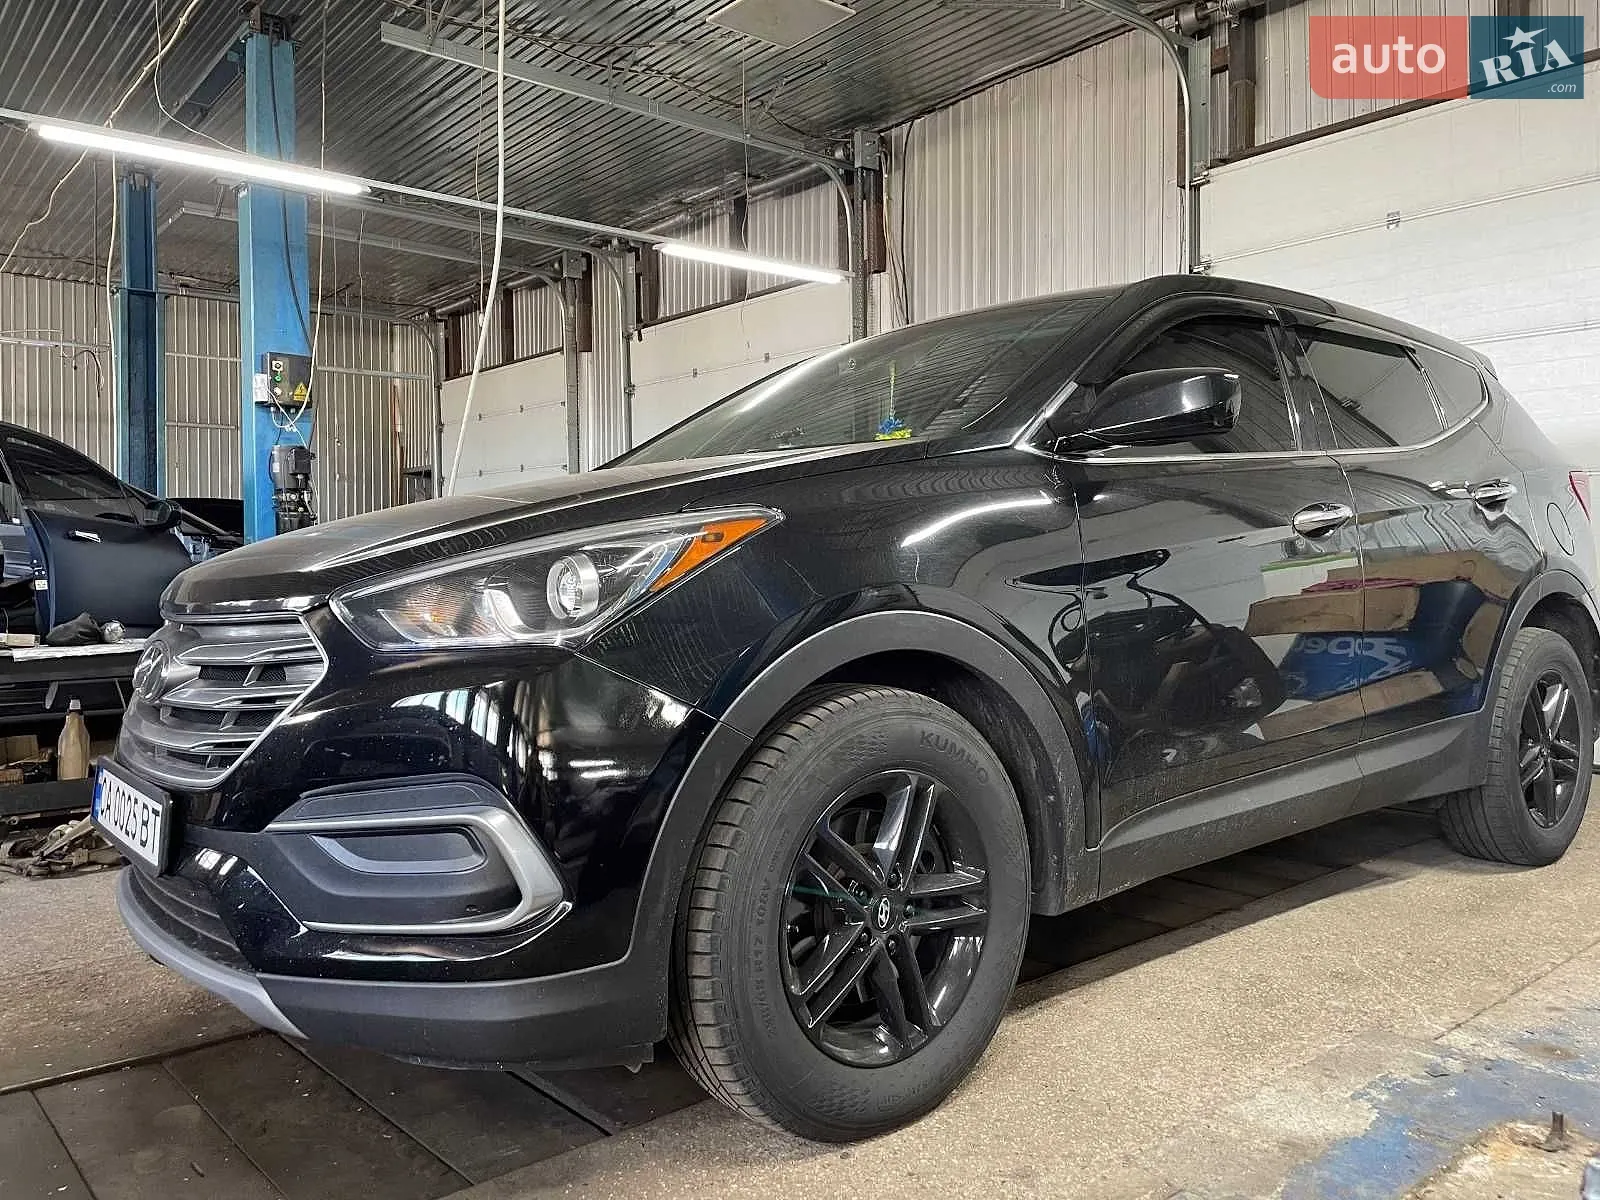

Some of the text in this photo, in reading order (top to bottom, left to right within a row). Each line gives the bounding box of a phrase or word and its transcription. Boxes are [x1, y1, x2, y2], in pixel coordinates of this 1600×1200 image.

[919, 729, 989, 785] KUMHO
[113, 785, 139, 841] 0025
[140, 802, 160, 854] BT
